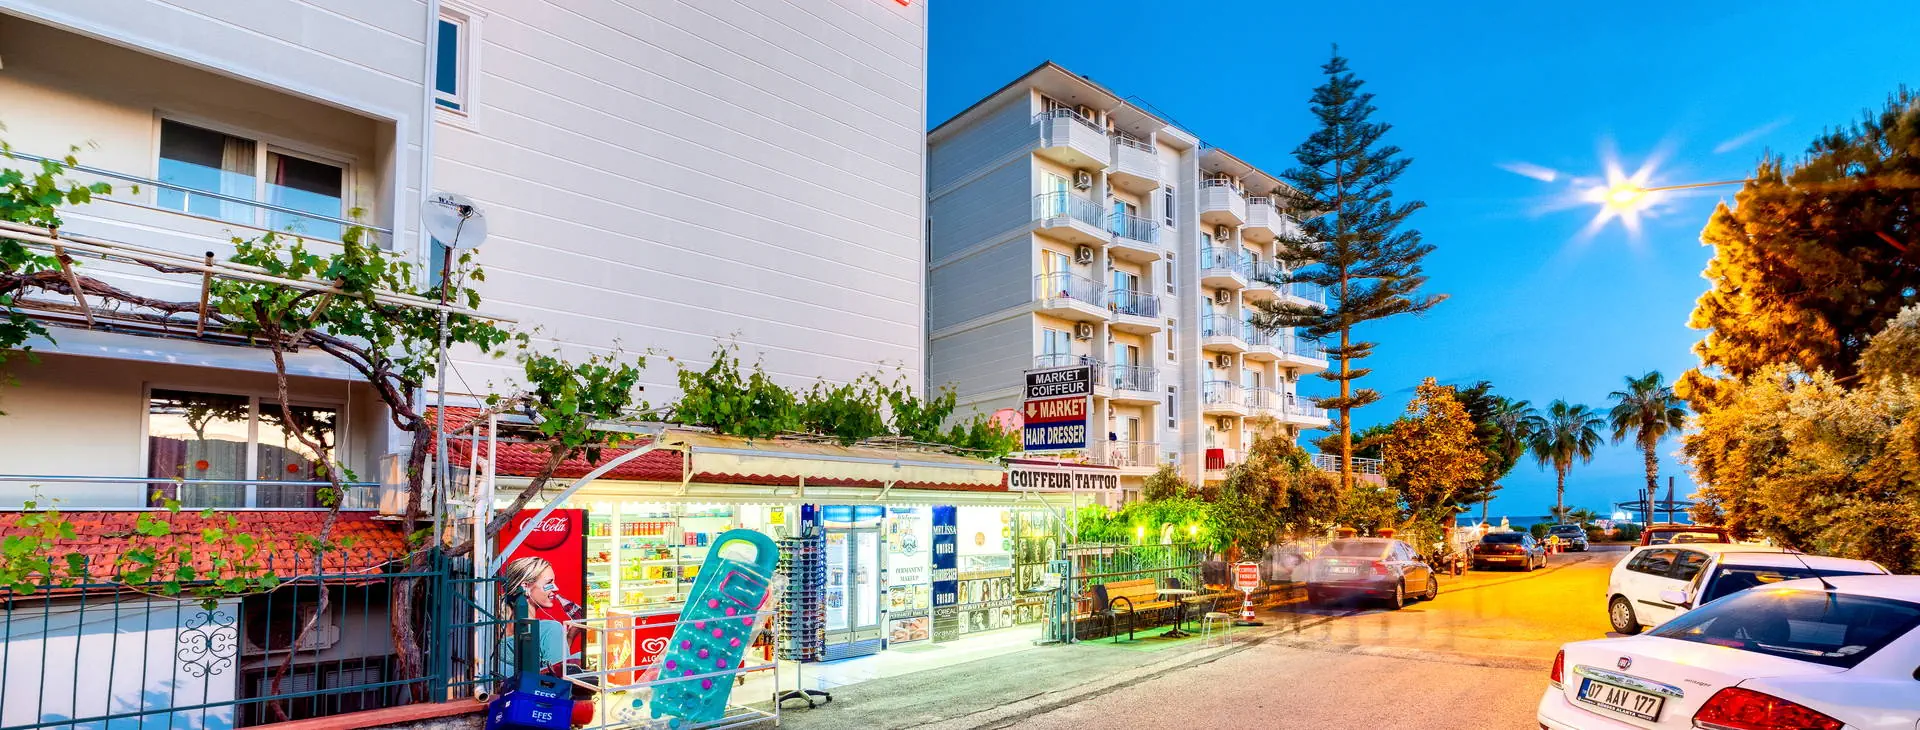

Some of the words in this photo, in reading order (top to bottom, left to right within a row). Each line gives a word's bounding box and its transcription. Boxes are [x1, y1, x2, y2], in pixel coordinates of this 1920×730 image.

[1035, 370, 1080, 384] MARKET
[1031, 382, 1085, 397] COIFFEUR
[1040, 398, 1086, 418] MARKET
[1026, 427, 1046, 445] HAIR
[1047, 425, 1085, 444] DRESSER
[1011, 470, 1071, 489] COIFFEUR
[1075, 474, 1117, 489] TATTOO
[1588, 683, 1603, 698] 07
[1606, 687, 1630, 707] AAV
[1633, 694, 1657, 713] 177
[532, 710, 553, 720] EFES
